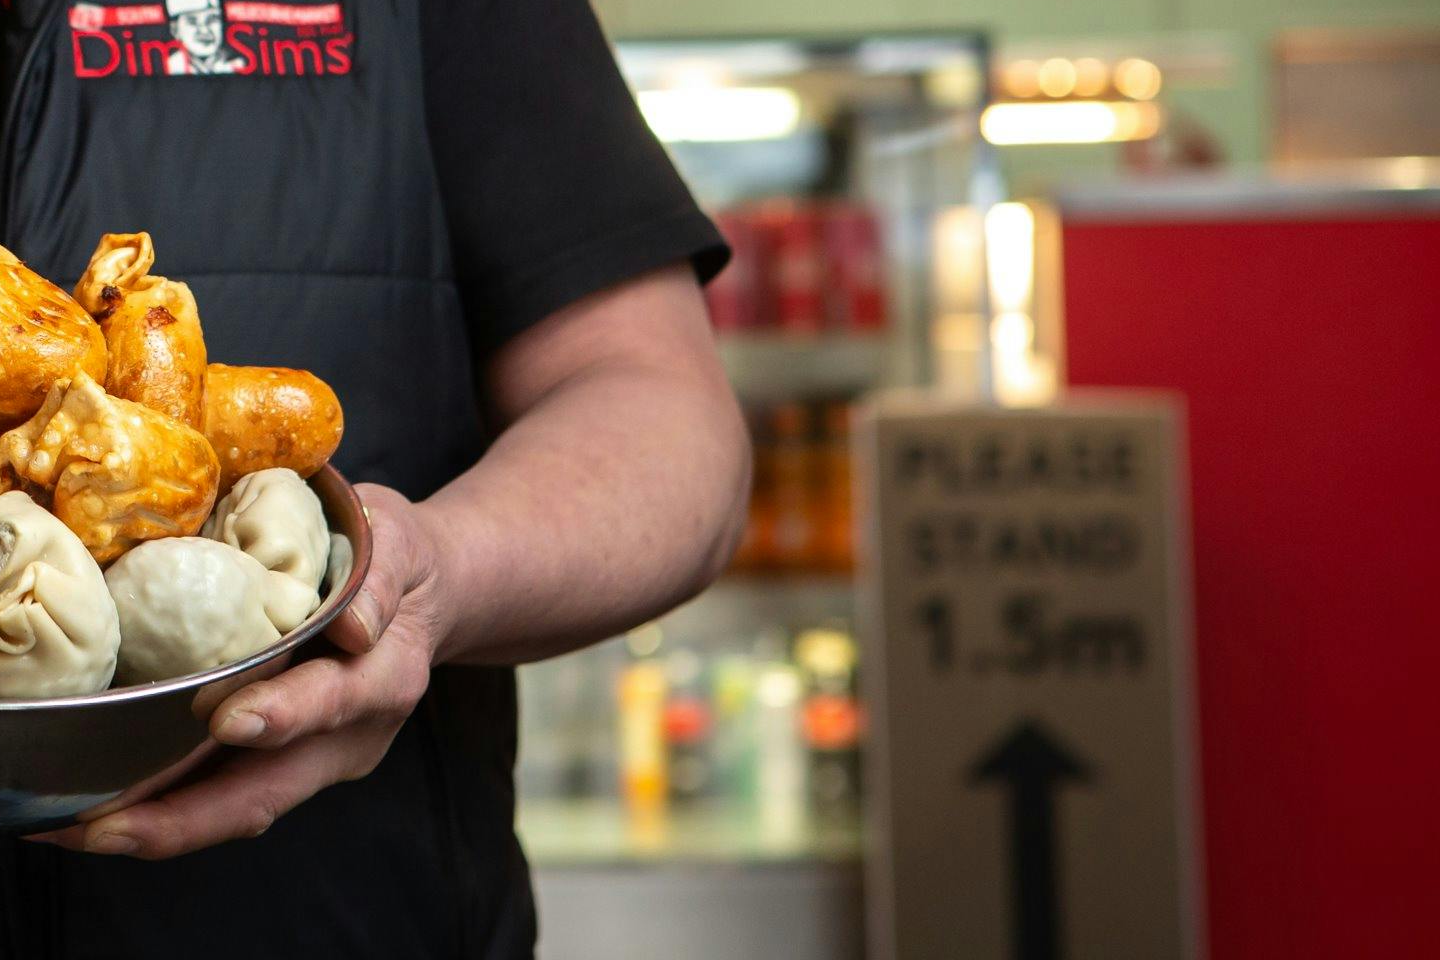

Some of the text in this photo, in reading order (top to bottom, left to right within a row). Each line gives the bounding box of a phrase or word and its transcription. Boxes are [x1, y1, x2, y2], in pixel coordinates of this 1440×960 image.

[71, 27, 194, 78] Dim
[896, 434, 1138, 491] PLEASE
[908, 513, 1141, 573] STAND
[917, 592, 1148, 676] 1.5m
